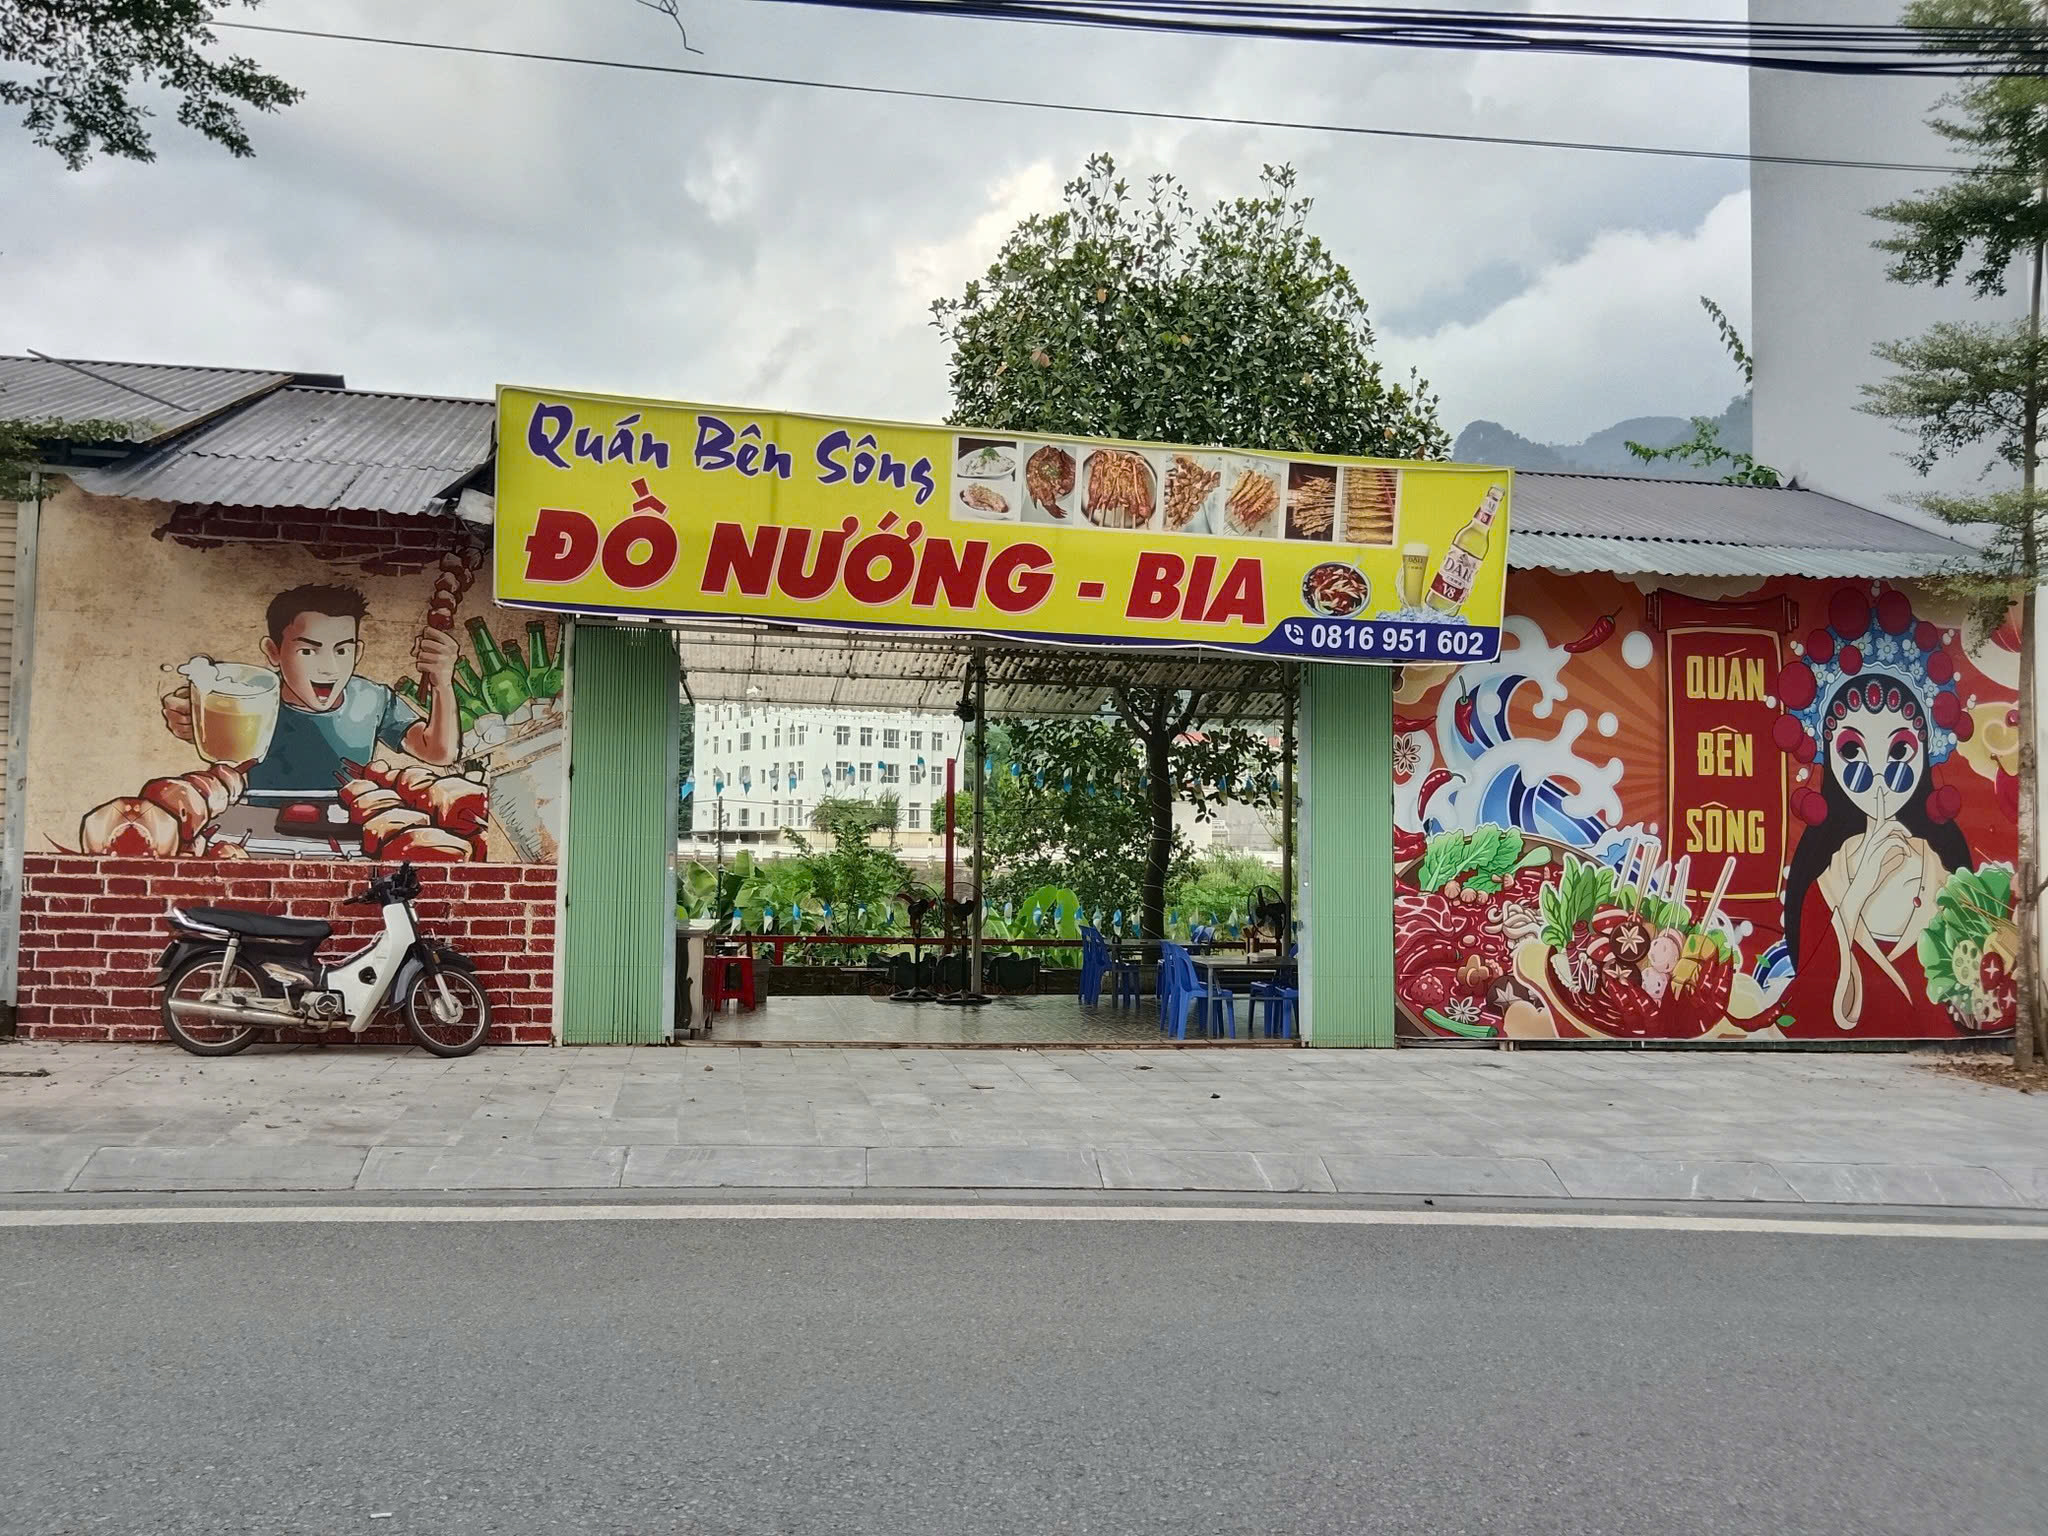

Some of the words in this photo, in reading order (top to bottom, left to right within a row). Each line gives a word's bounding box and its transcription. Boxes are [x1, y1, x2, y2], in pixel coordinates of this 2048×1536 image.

[528, 402, 670, 469] Quán
[694, 415, 793, 479] Bên
[815, 429, 935, 506] Sông
[524, 477, 679, 589] ĐỒ
[700, 510, 1055, 612] NƯỚNG
[1124, 551, 1267, 625] BIA
[1442, 582, 1456, 598] V8
[1310, 623, 1375, 650] 0816
[1382, 627, 1427, 653] 951
[1437, 630, 1485, 656] 602
[1685, 647, 1765, 701] QUÁN
[1696, 724, 1754, 777] BÊN
[1685, 800, 1765, 854] SÔNG
